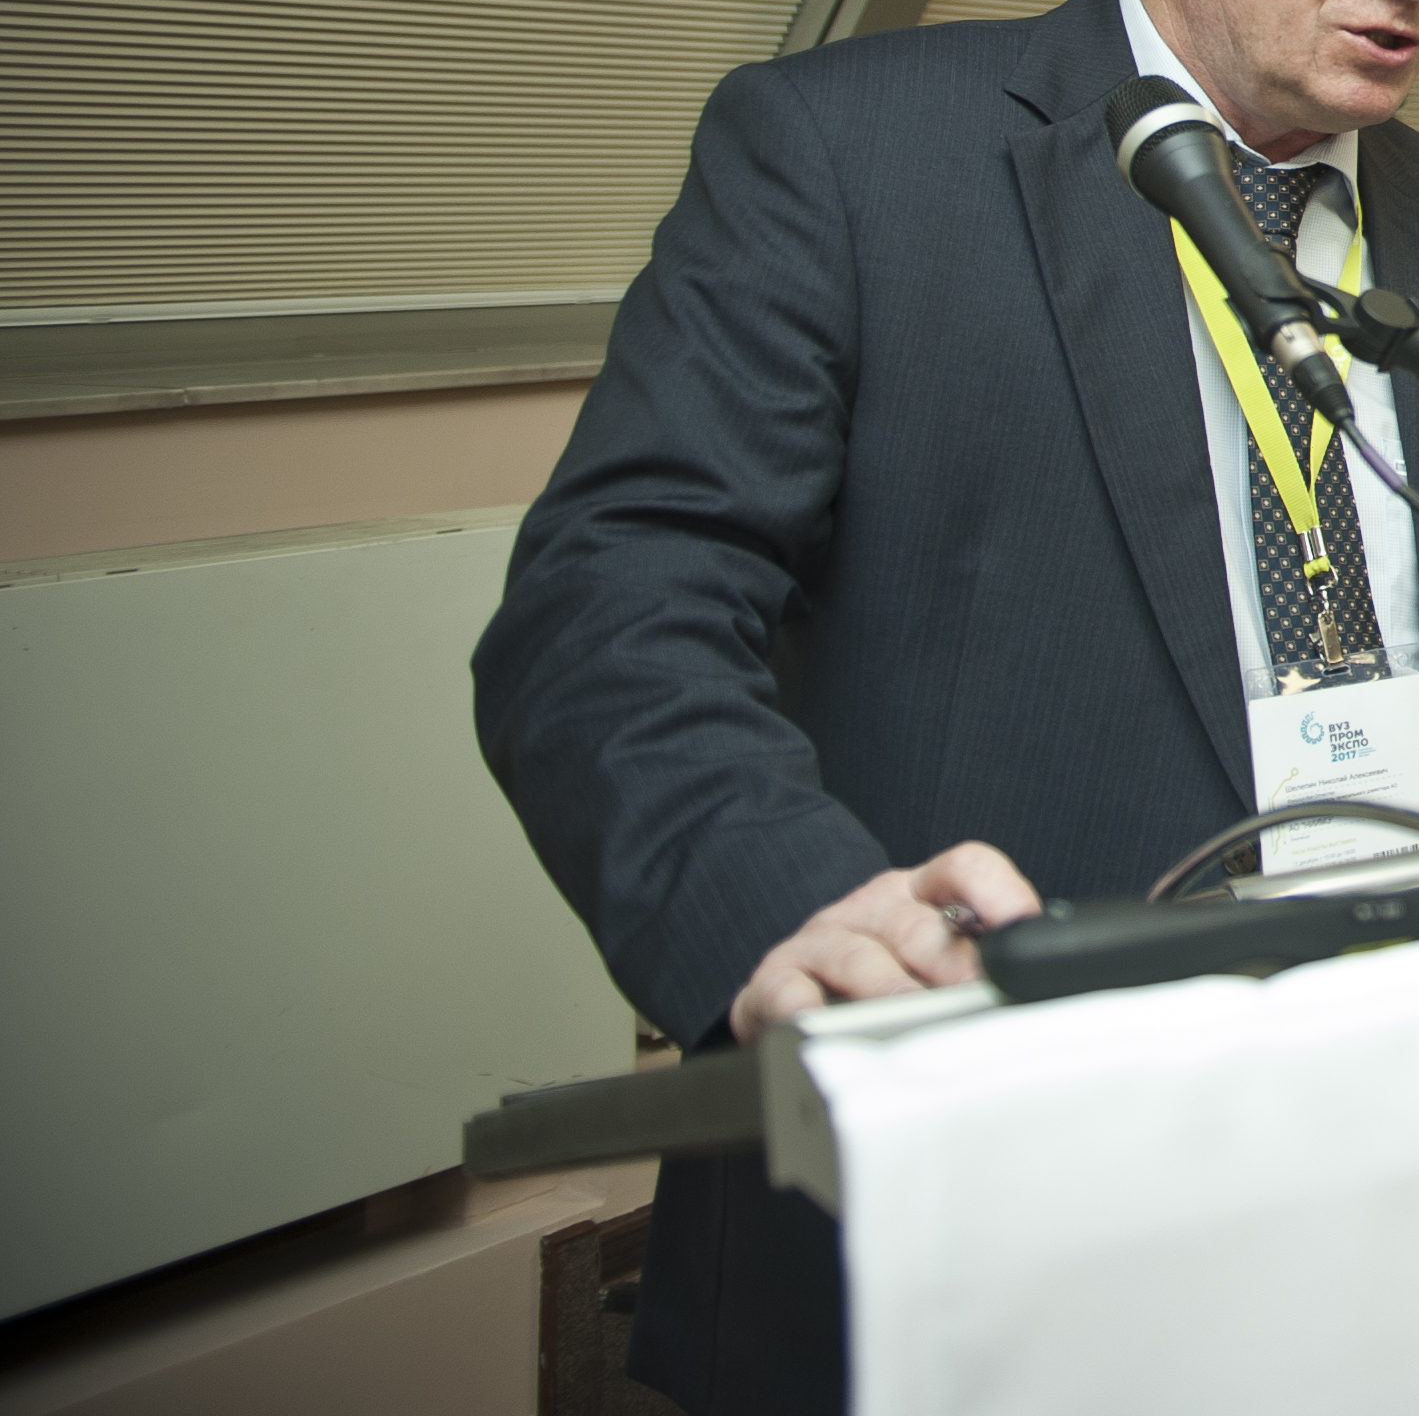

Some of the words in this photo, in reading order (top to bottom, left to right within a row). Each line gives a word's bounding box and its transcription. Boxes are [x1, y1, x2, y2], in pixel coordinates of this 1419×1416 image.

[1328, 721, 1350, 733] ВУЗ
[1329, 729, 1364, 743] ПРОМ
[1331, 738, 1369, 753] ЭКСПО
[1331, 750, 1356, 763] 2017
